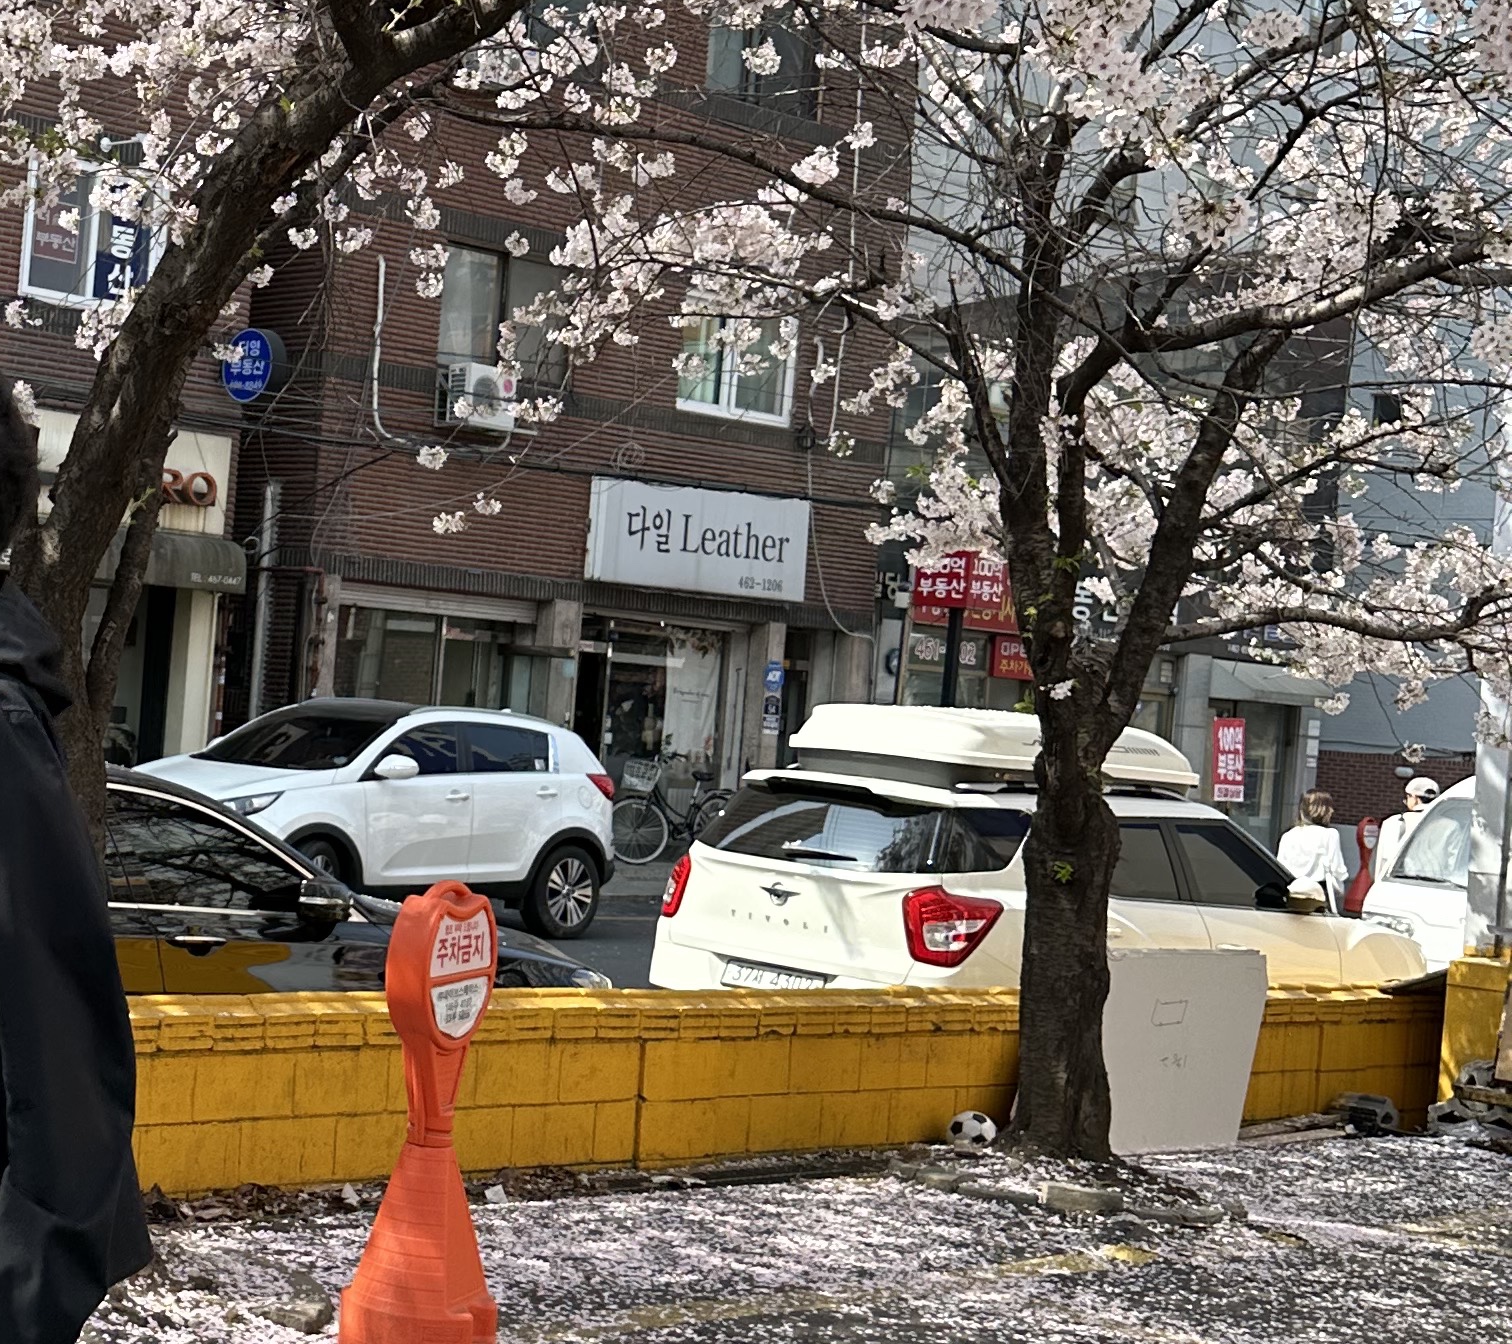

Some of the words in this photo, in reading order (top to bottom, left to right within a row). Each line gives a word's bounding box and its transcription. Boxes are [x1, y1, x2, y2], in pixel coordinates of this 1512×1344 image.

[36, 230, 76, 253] 부동산
[161, 468, 218, 507] RO
[627, 504, 672, 553] 다일
[680, 513, 790, 563] Leather
[738, 576, 783, 593] 462-1206
[917, 577, 967, 599] 부동산
[970, 579, 1005, 603] 부동산
[731, 908, 829, 934] TIVOLI
[436, 931, 486, 969] 주차금지
